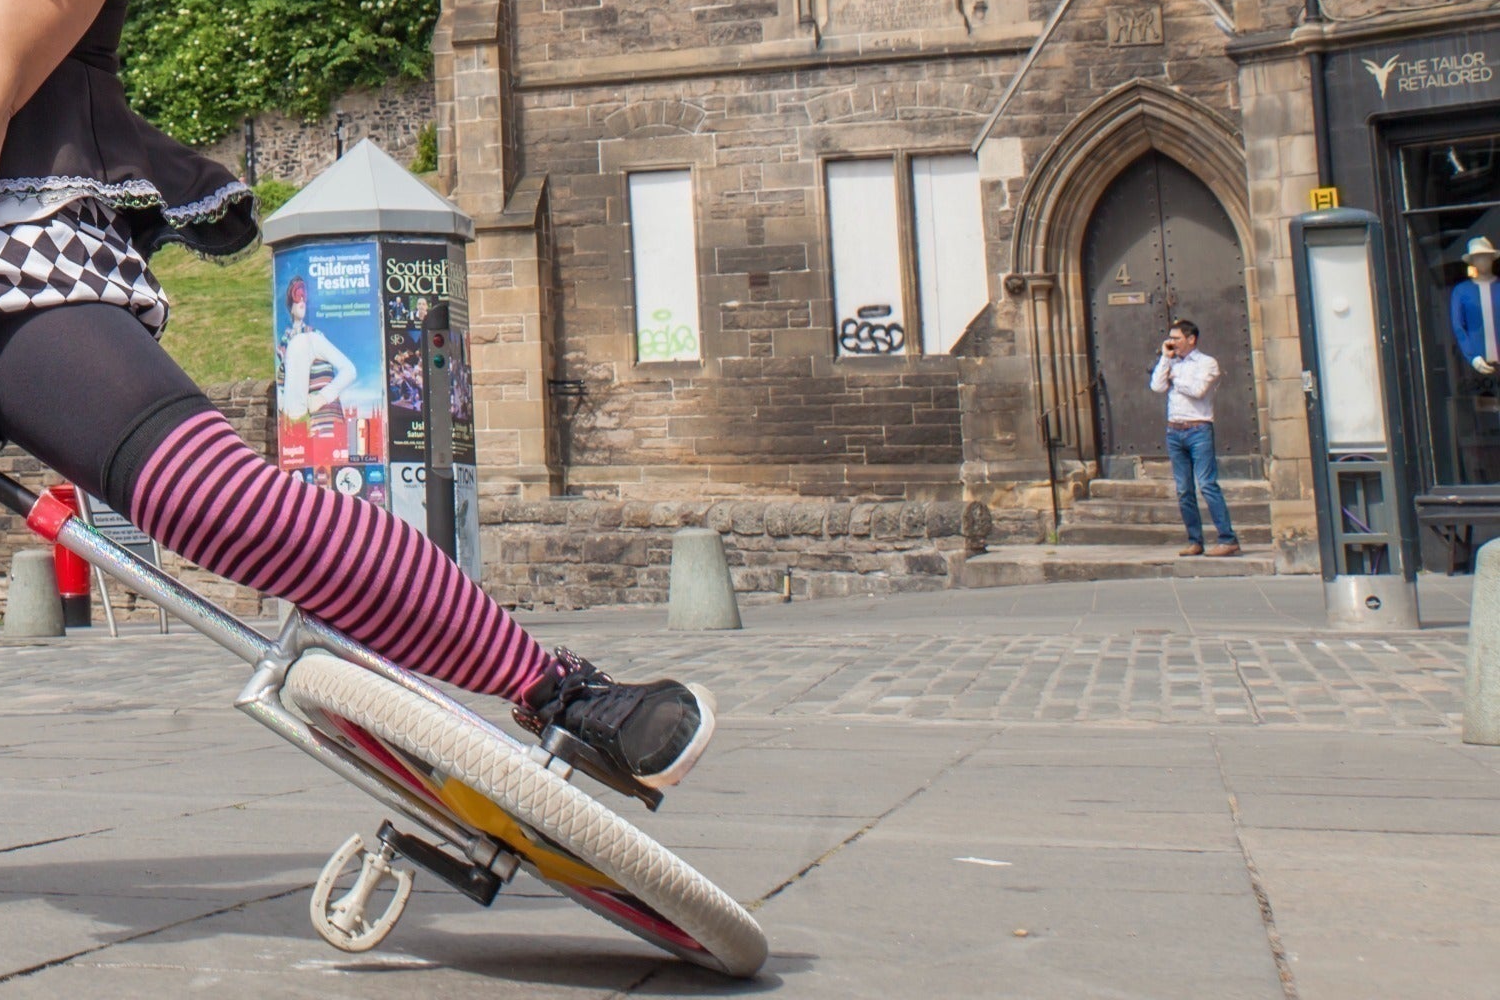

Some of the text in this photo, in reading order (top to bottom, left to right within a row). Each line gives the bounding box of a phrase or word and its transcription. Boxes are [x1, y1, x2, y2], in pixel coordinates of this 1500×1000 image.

[1398, 52, 1485, 75] THE TAILOR
[1399, 67, 1492, 92] RETAILORED
[309, 260, 371, 278] Children's
[1115, 263, 1132, 287] 4
[317, 273, 371, 290] Festival
